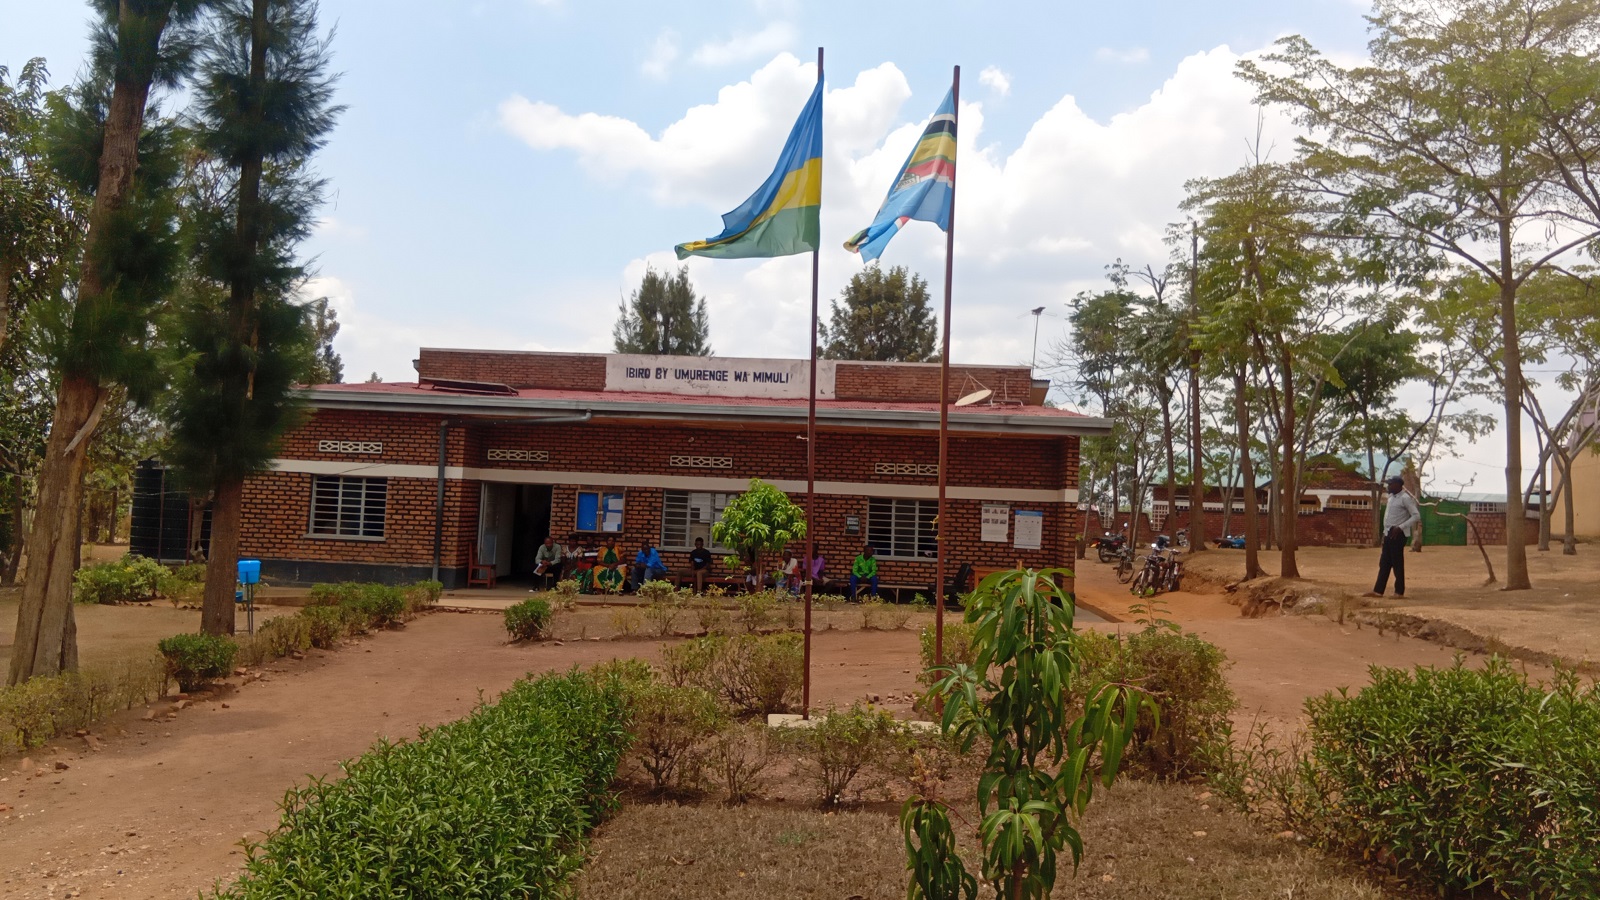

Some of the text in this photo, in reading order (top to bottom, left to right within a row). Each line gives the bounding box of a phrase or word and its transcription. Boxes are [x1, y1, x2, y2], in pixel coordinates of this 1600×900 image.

[626, 367, 789, 384] IBIRO BY UMURENGE WA MIMULI
